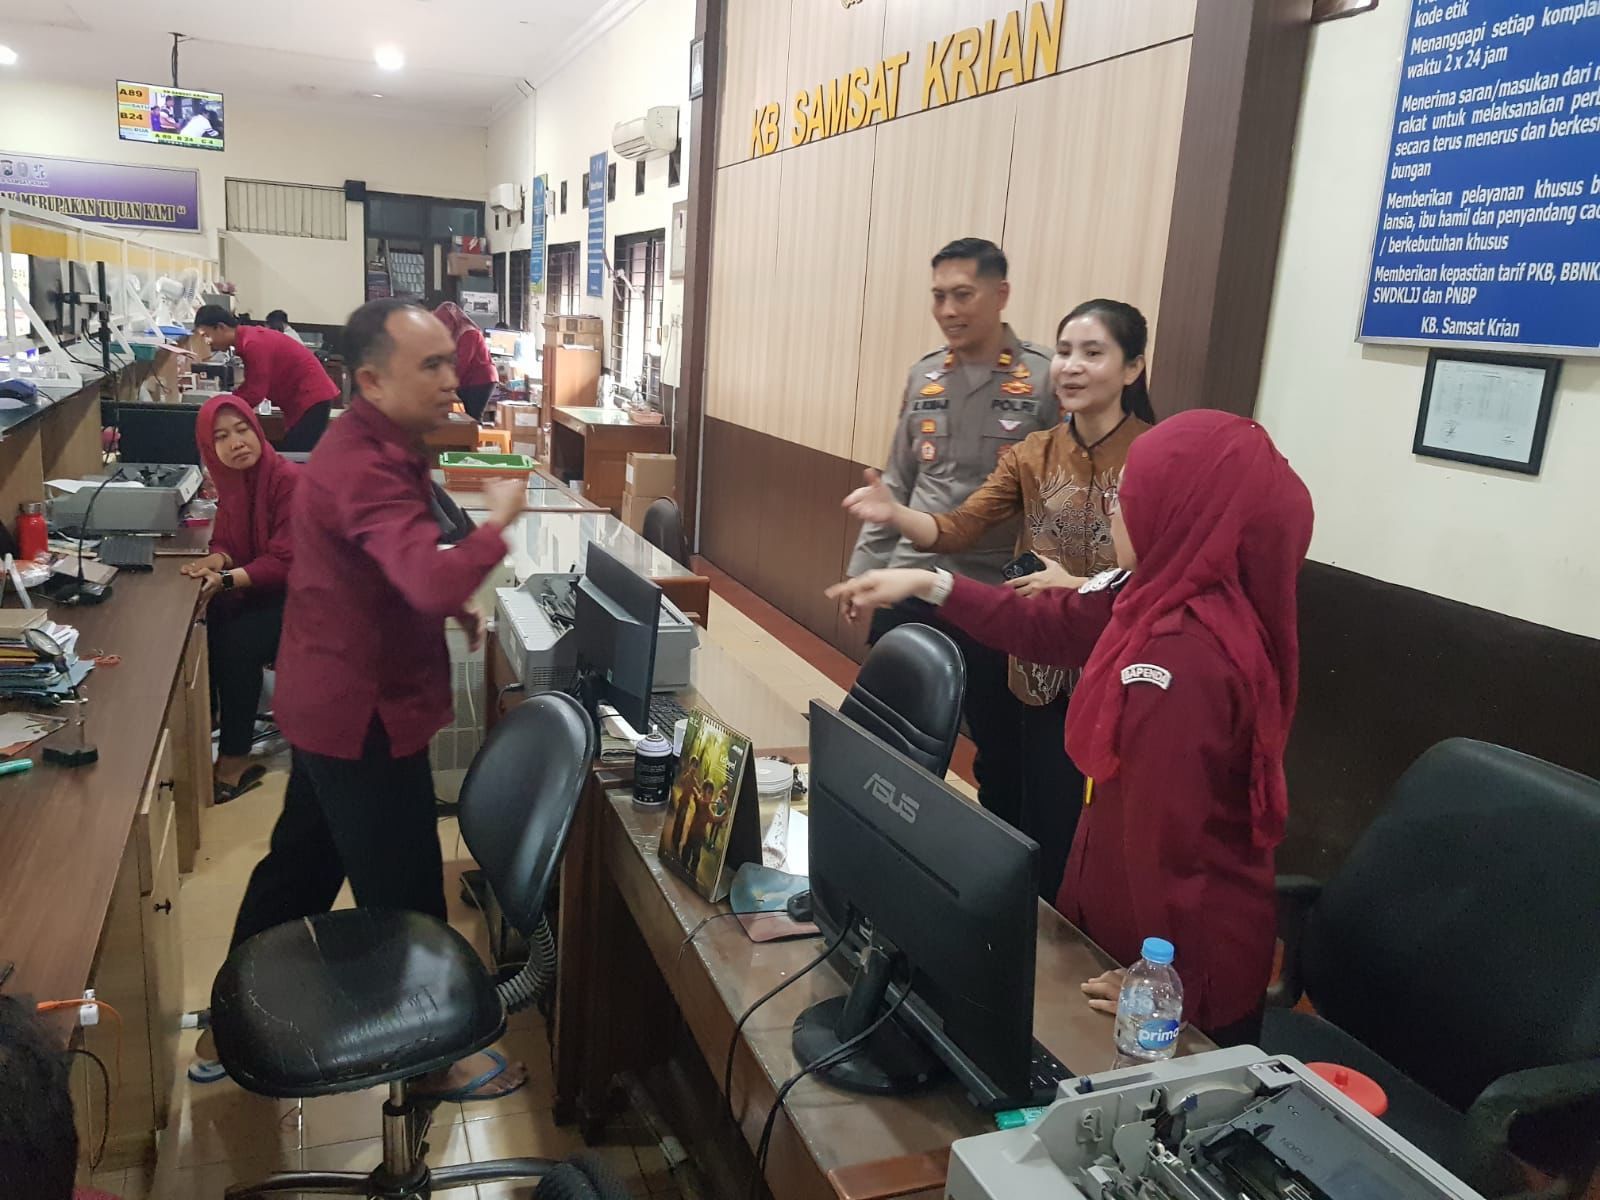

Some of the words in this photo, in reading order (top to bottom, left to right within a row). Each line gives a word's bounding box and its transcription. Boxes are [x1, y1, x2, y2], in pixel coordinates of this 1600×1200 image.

[1414, 5, 1443, 28] kode
[1445, 0, 1469, 20] etik
[1410, 21, 1487, 55] Menanggapi
[1491, 14, 1535, 38] setiap
[1407, 58, 1442, 79] waktu
[1444, 54, 1452, 72] 2
[1453, 55, 1463, 71] x
[1464, 48, 1481, 68] 24
[1481, 45, 1508, 70] jam
[119, 88, 143, 97] A89
[752, 102, 780, 159] KB
[792, 51, 909, 146] SAMSAT
[922, 0, 1065, 111] KRIAN
[1401, 89, 1457, 112] Menerima
[1458, 72, 1559, 104] saran/masukan
[1562, 62, 1593, 87] dari
[120, 111, 143, 120] B24
[1398, 115, 1428, 134] rakat
[1432, 107, 1467, 130] untuk
[1471, 94, 1564, 125] melaksanakan
[1395, 139, 1430, 156] secara
[1432, 135, 1463, 152] terus
[1464, 127, 1519, 149] menerus
[1520, 121, 1546, 141] dan
[1391, 162, 1432, 182] bungan
[18, 192, 95, 216] MERUPAKAN
[99, 200, 141, 220] TUJUAN
[144, 202, 175, 222] KAMI
[1386, 188, 1453, 210] Memberikan
[1460, 184, 1525, 209] pelayanan
[1534, 178, 1584, 199] khusus
[1383, 211, 1416, 233] lansia,
[1418, 210, 1437, 228] ibu
[1438, 207, 1471, 227] hamil
[1472, 206, 1495, 226] dan
[1496, 202, 1577, 229] penyandang
[1379, 236, 1387, 256] /
[1387, 233, 1464, 253] berkebutuhan
[1465, 232, 1509, 251] khusus
[1374, 264, 1438, 282] Memberikan
[1439, 263, 1495, 286] kepastian
[1498, 262, 1527, 281] tarif
[1526, 262, 1556, 286] PKB,
[1560, 262, 1600, 281] BBNK
[1373, 286, 1421, 304] SWDKLJJ
[1422, 286, 1443, 304] dan
[1444, 286, 1477, 305] PNBP
[1421, 316, 1438, 334] KB.
[1441, 316, 1486, 336] Samsat
[1487, 318, 1520, 337] Krian
[863, 773, 920, 824] ASUS
